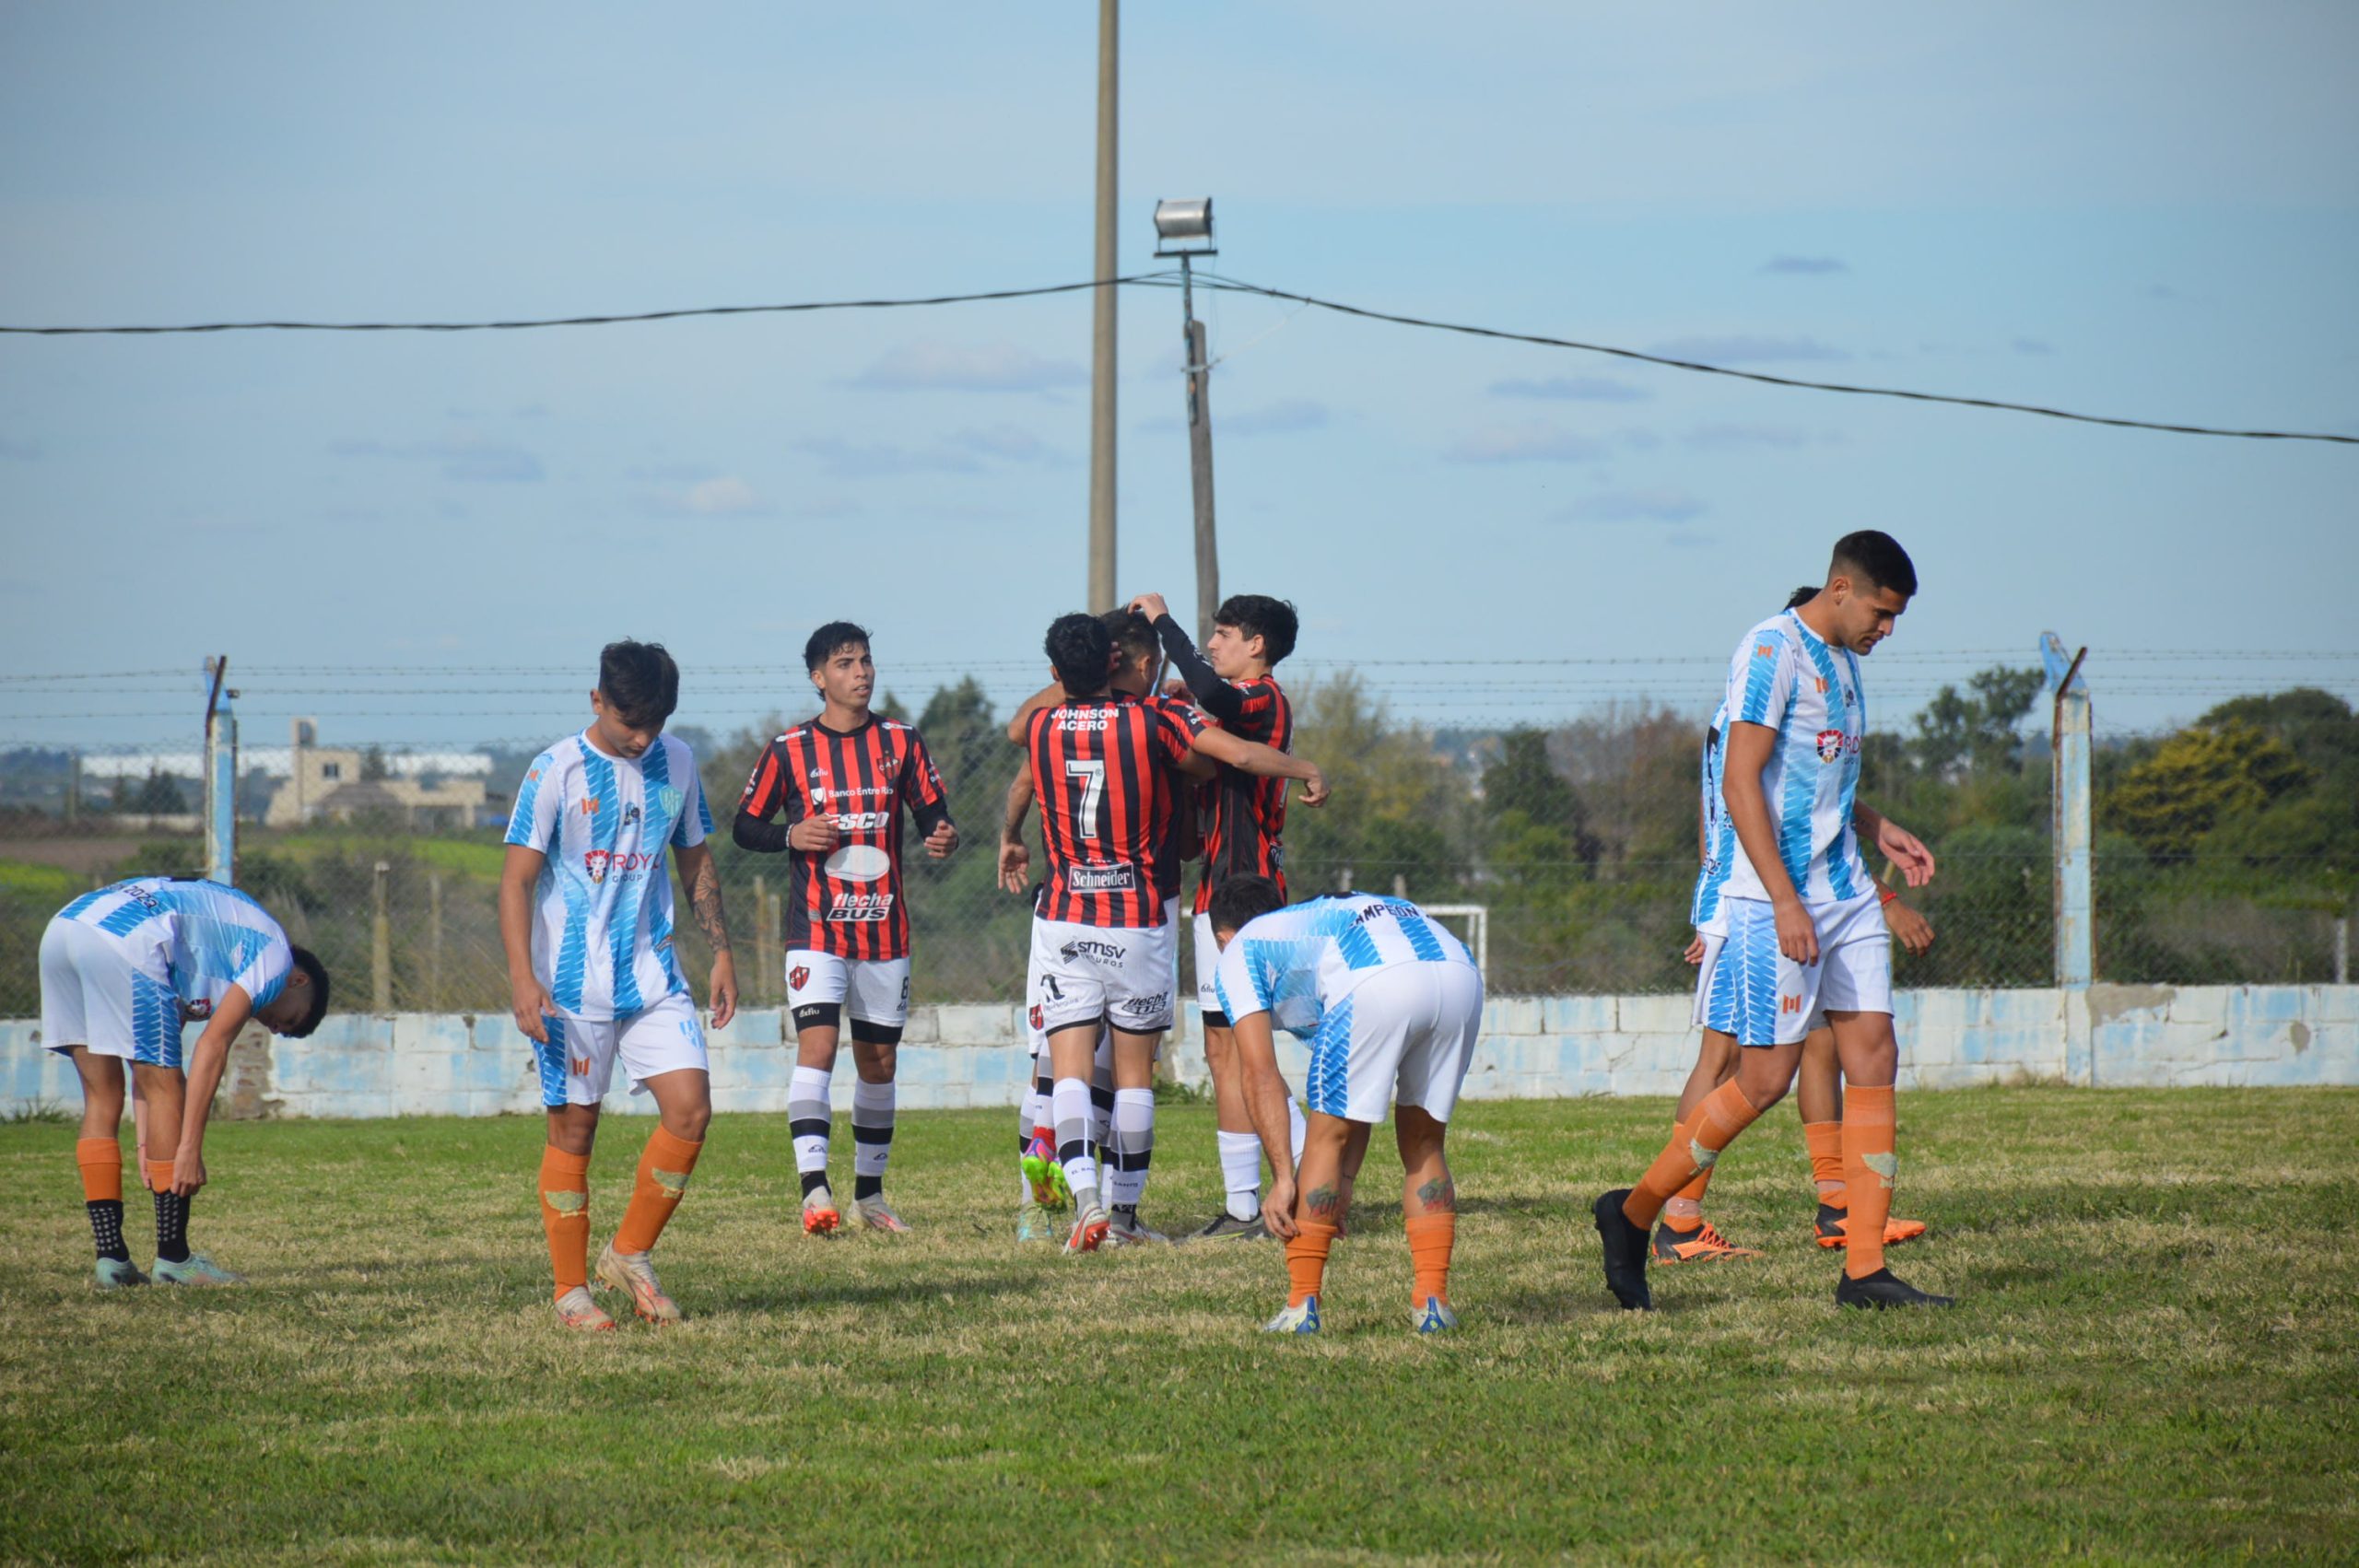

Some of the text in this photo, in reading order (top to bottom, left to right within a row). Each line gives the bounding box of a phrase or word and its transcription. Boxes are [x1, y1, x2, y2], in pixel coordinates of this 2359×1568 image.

[1050, 708, 1120, 720] JOHNSON
[1057, 720, 1109, 731] ACERO
[827, 790, 856, 799] Banco
[856, 787, 880, 796] Entre
[1065, 759, 1105, 838] 7
[612, 873, 643, 883] GOUP
[1073, 870, 1131, 887] Schneider
[832, 892, 895, 908] flecha
[828, 907, 886, 920] BUS
[900, 977, 910, 1000] 8
